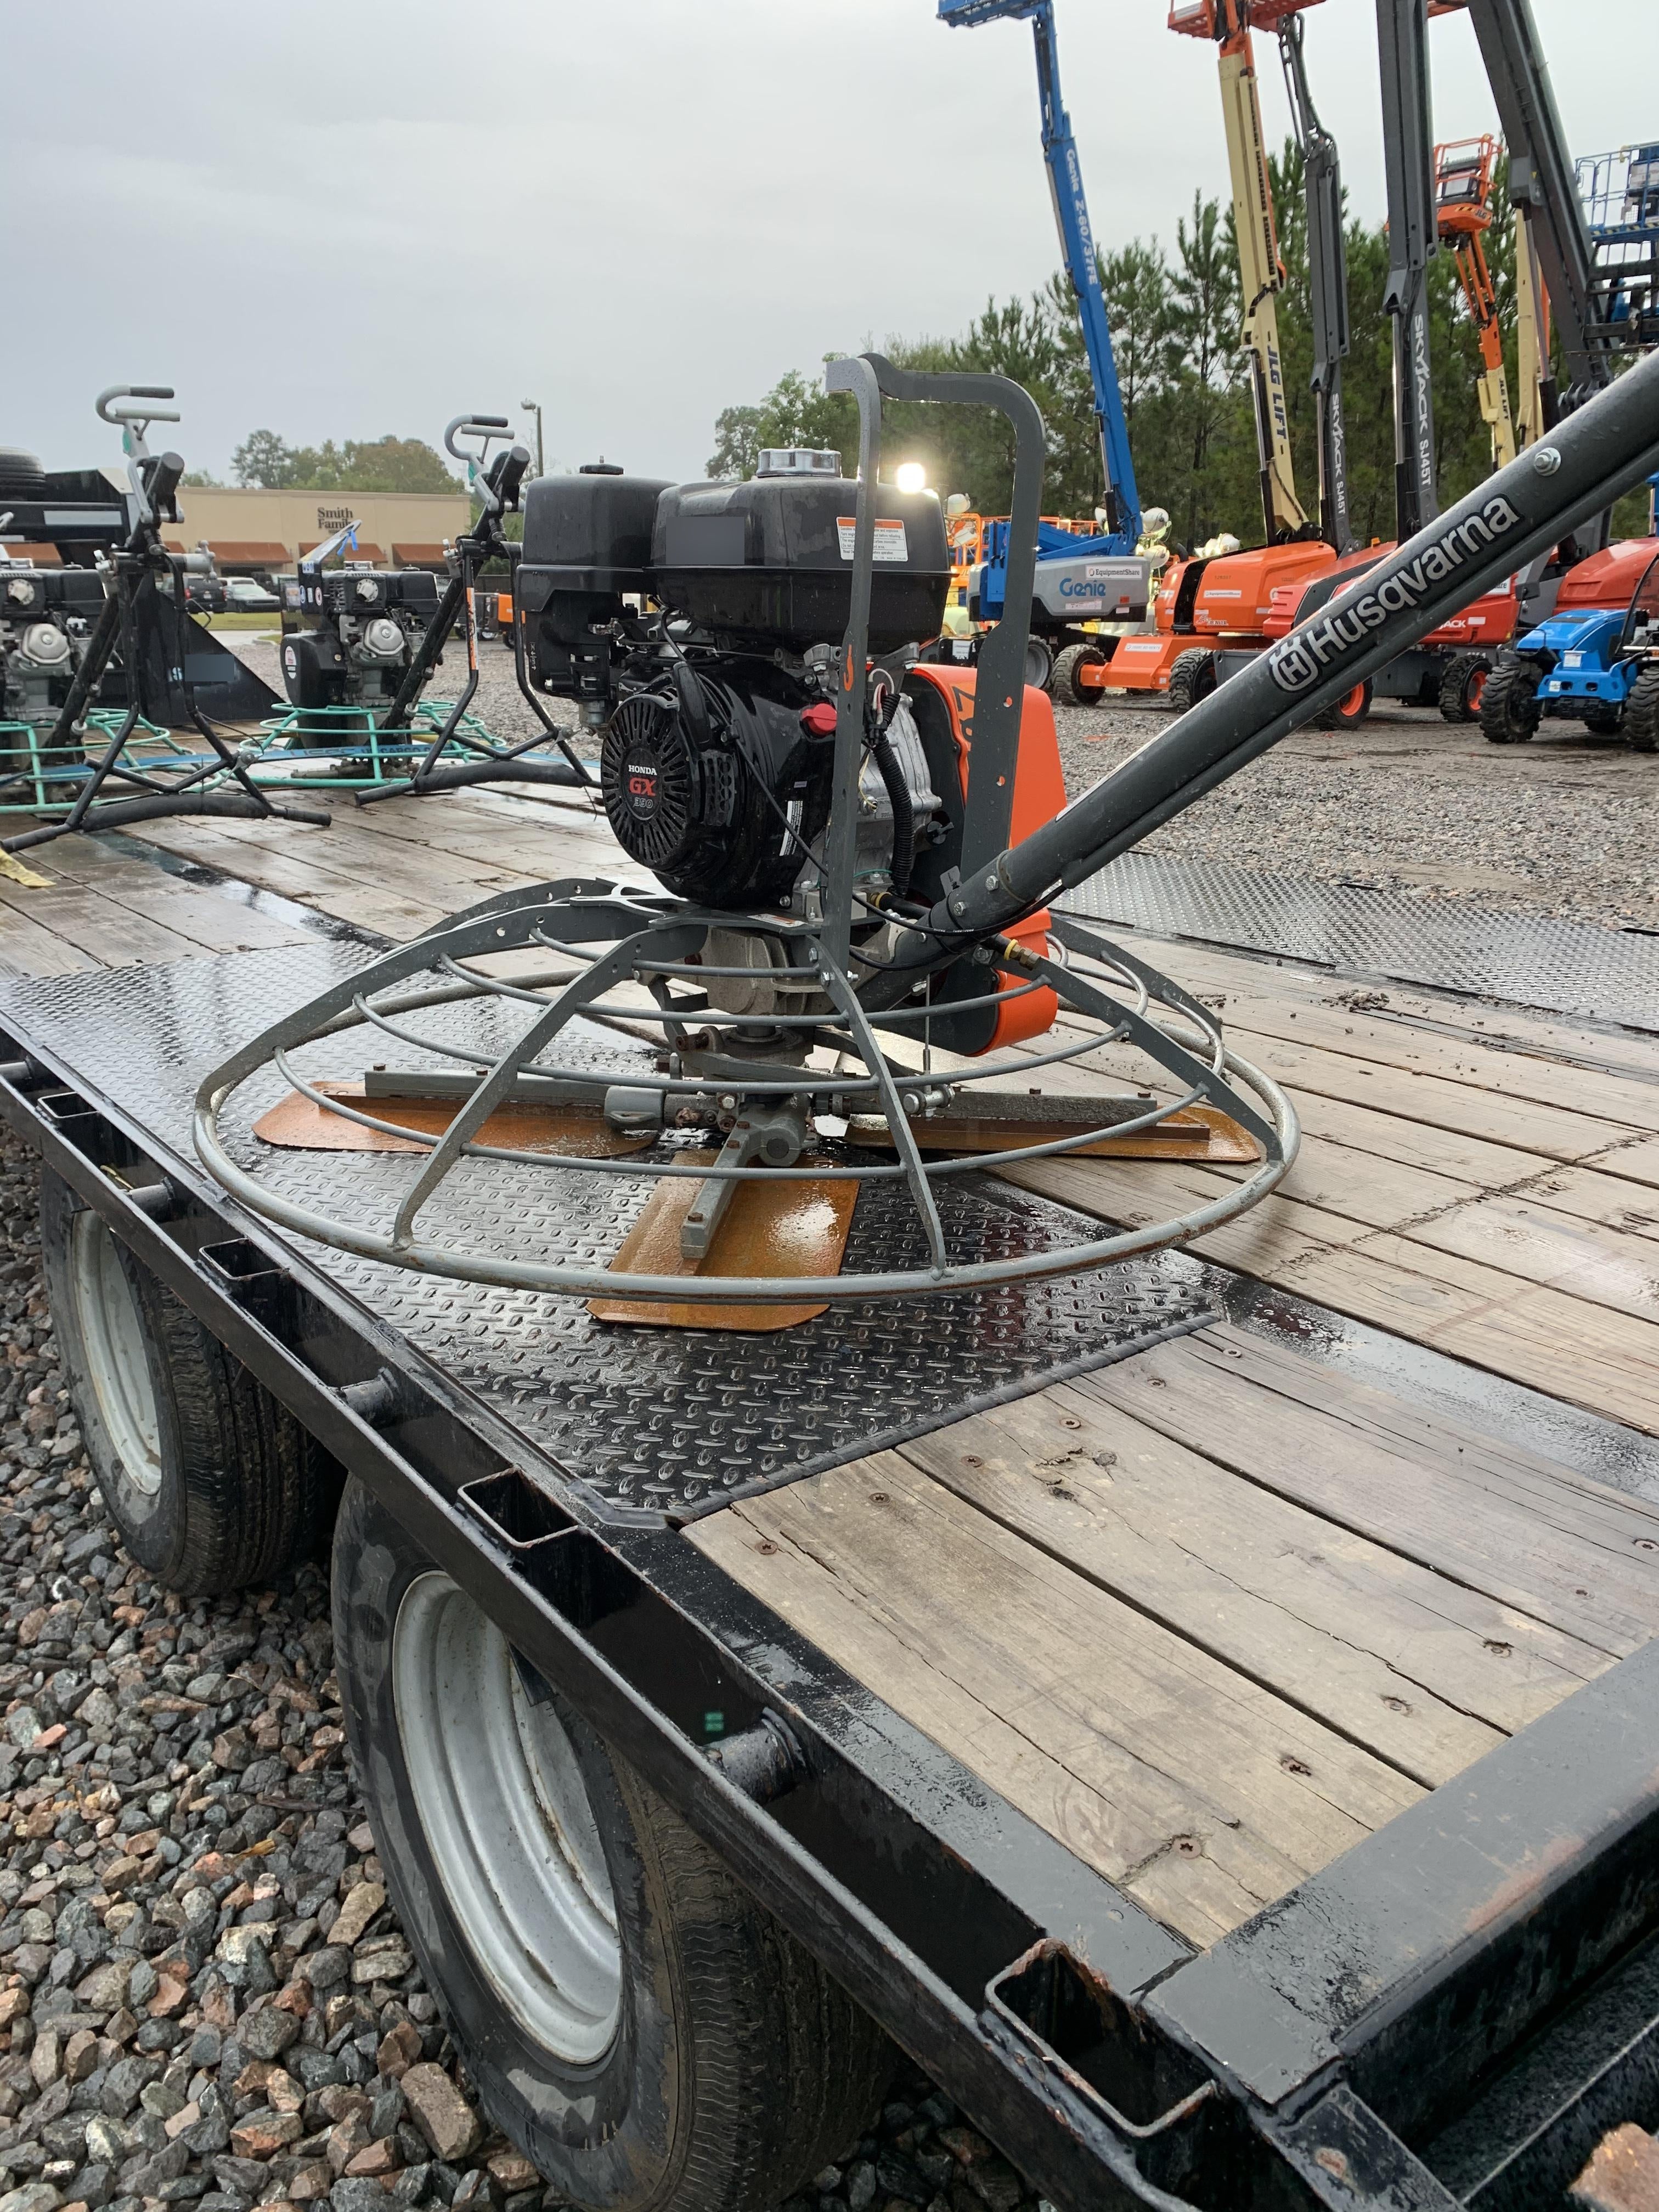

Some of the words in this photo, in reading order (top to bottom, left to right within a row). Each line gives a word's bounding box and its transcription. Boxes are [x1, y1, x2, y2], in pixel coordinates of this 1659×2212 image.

[1066, 149, 1079, 192] Genie
[1075, 199, 1098, 285] Z-60/37FE
[1268, 345, 1281, 386] JLG
[1414, 313, 1431, 435] SKYJACK
[1272, 392, 1287, 439] LIFT
[1332, 393, 1344, 478] SKYJACK
[1419, 438, 1431, 486] SJ45T
[317, 506, 353, 518] Smith
[1336, 482, 1346, 515] SJ45T
[318, 518, 352, 529] Famil
[1059, 578, 1106, 597] Genie
[1306, 496, 1521, 665] Husqvarna
[628, 764, 658, 776] HONDA
[629, 777, 657, 797] GX
